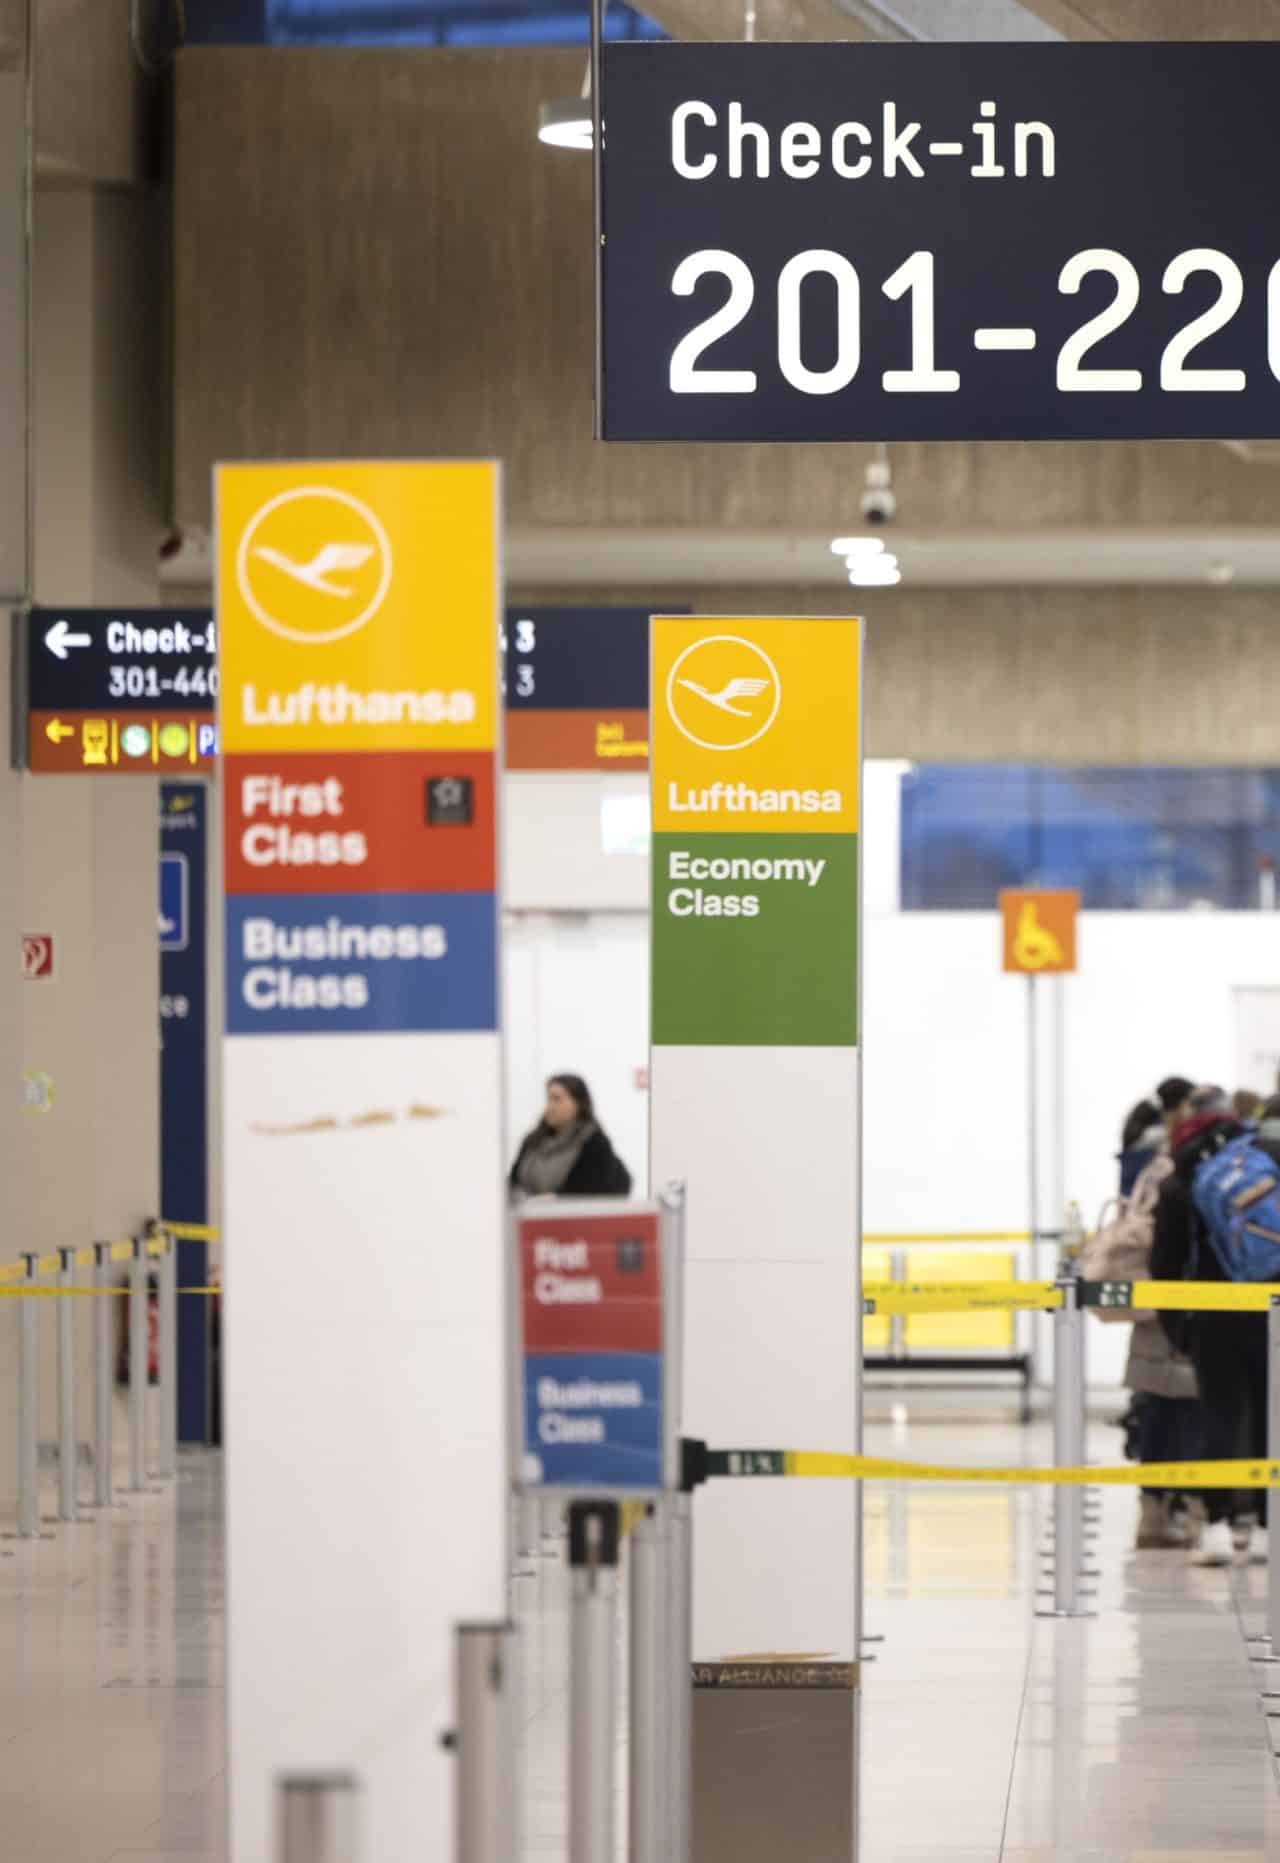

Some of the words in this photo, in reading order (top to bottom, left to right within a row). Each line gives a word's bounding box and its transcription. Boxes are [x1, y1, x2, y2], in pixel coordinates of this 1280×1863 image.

[671, 101, 1056, 180] Check-in
[242, 684, 475, 726] Lufthansa
[242, 776, 344, 817] First
[668, 782, 841, 813] Lufthansa
[241, 825, 368, 867] Class
[668, 851, 826, 887] Economy
[667, 888, 760, 917] Class
[242, 918, 447, 961] Business
[242, 968, 369, 1010] Class
